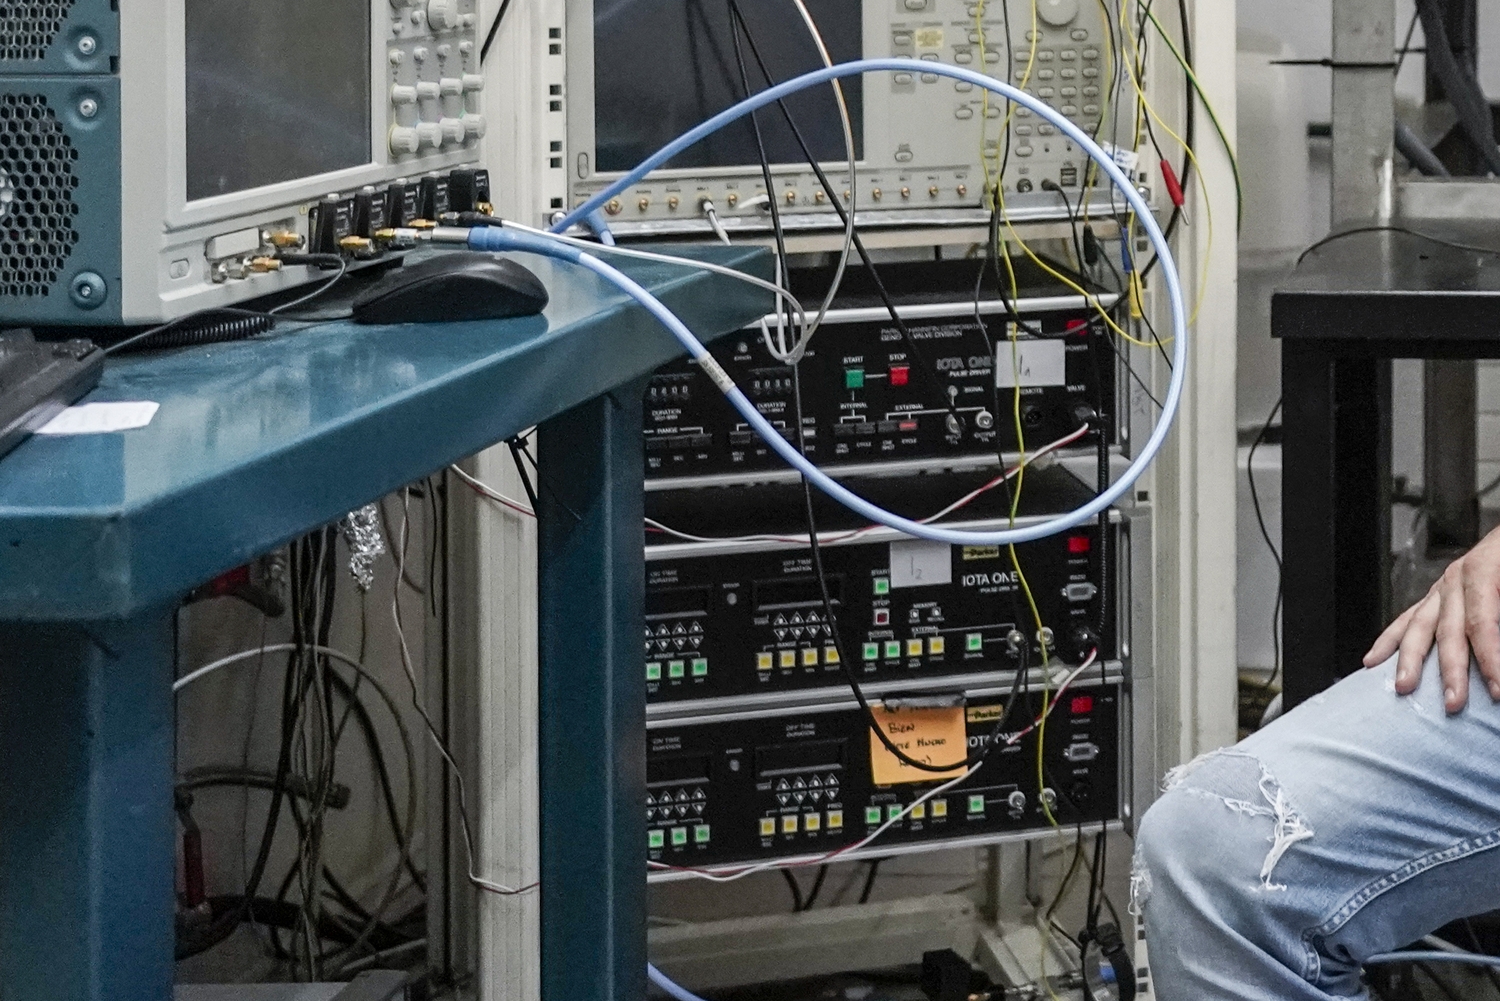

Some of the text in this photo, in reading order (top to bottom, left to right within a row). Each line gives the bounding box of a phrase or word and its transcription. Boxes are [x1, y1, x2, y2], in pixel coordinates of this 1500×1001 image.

[843, 355, 864, 363] START
[889, 353, 907, 361] STOP
[936, 357, 964, 370] IOTA
[963, 571, 1018, 587] IOTA ONE
